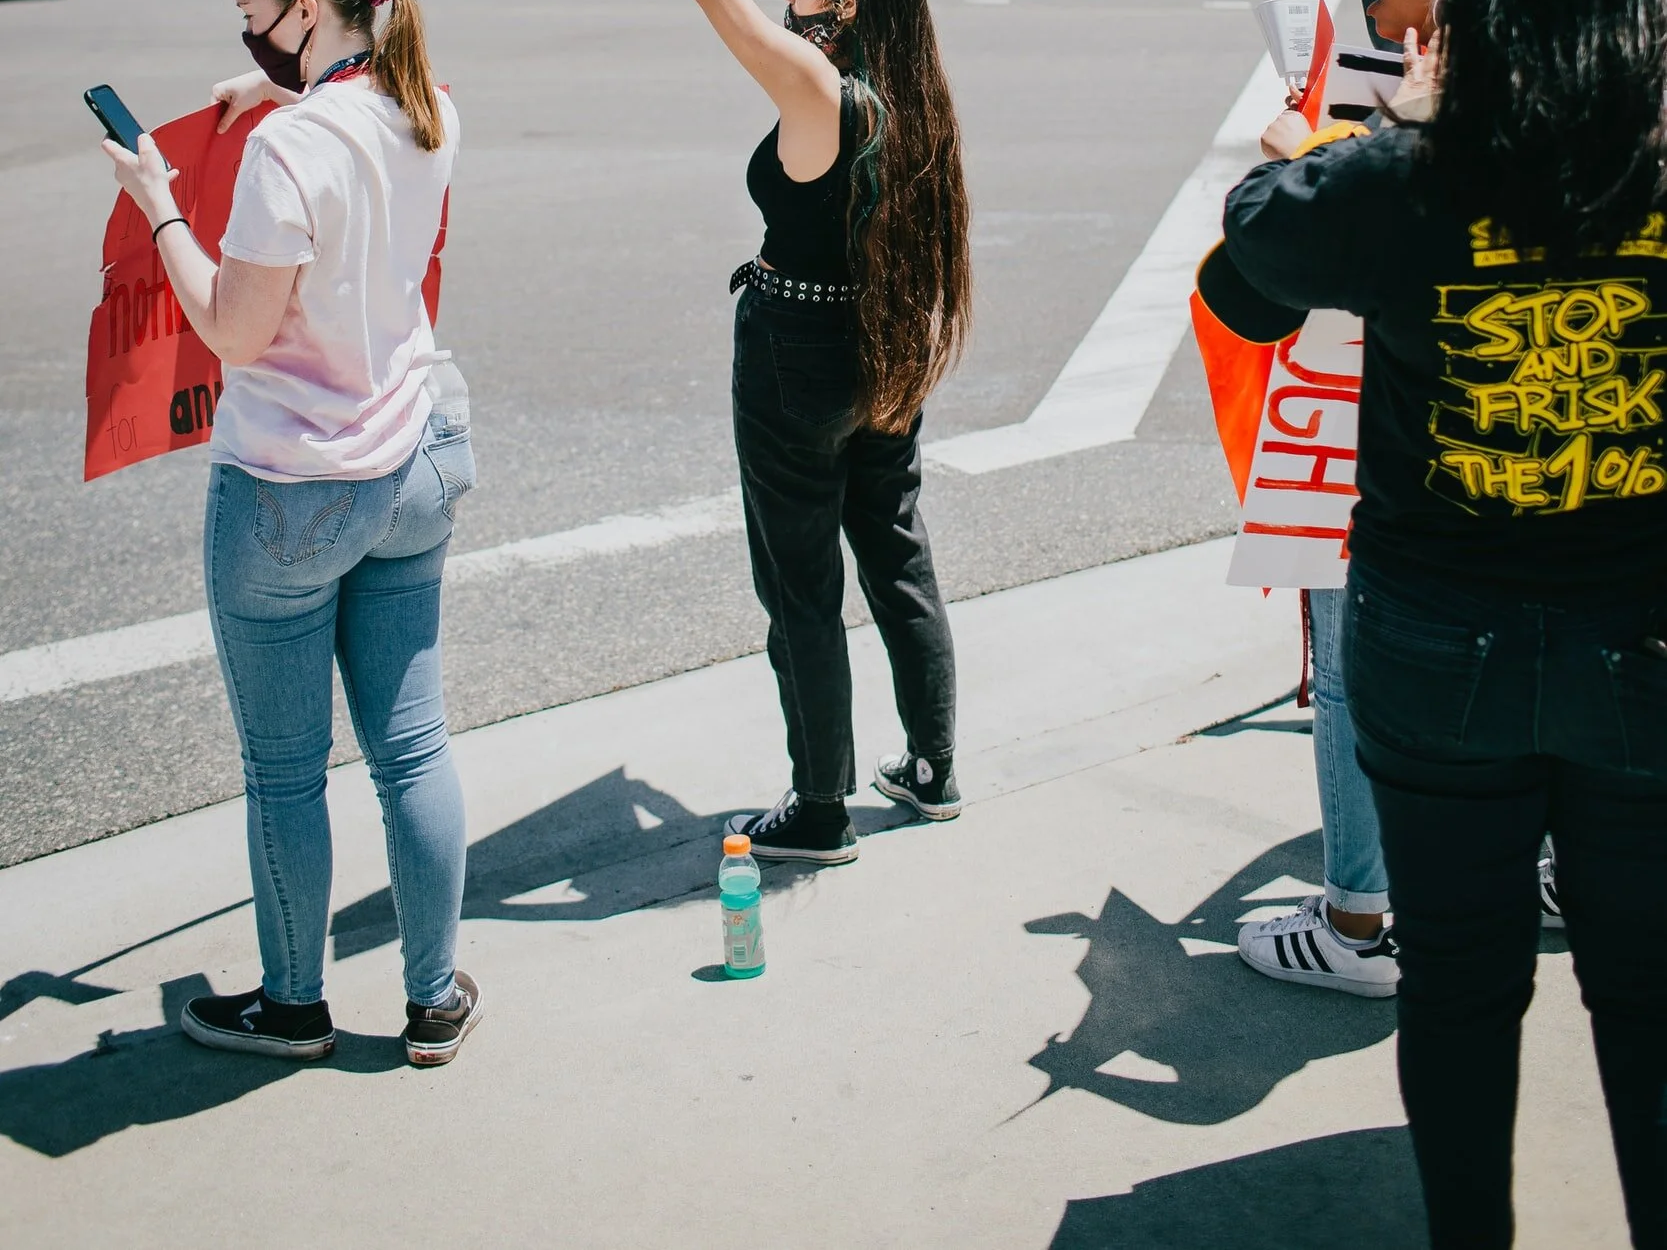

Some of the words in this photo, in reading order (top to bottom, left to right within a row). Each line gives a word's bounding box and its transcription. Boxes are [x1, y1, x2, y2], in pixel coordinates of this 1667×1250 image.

[1465, 283, 1651, 358] STOP
[1511, 340, 1617, 385] AND
[106, 382, 138, 461] for
[1469, 369, 1666, 434] FRISK
[1440, 450, 1549, 507] THE
[1540, 430, 1666, 513] 1%
